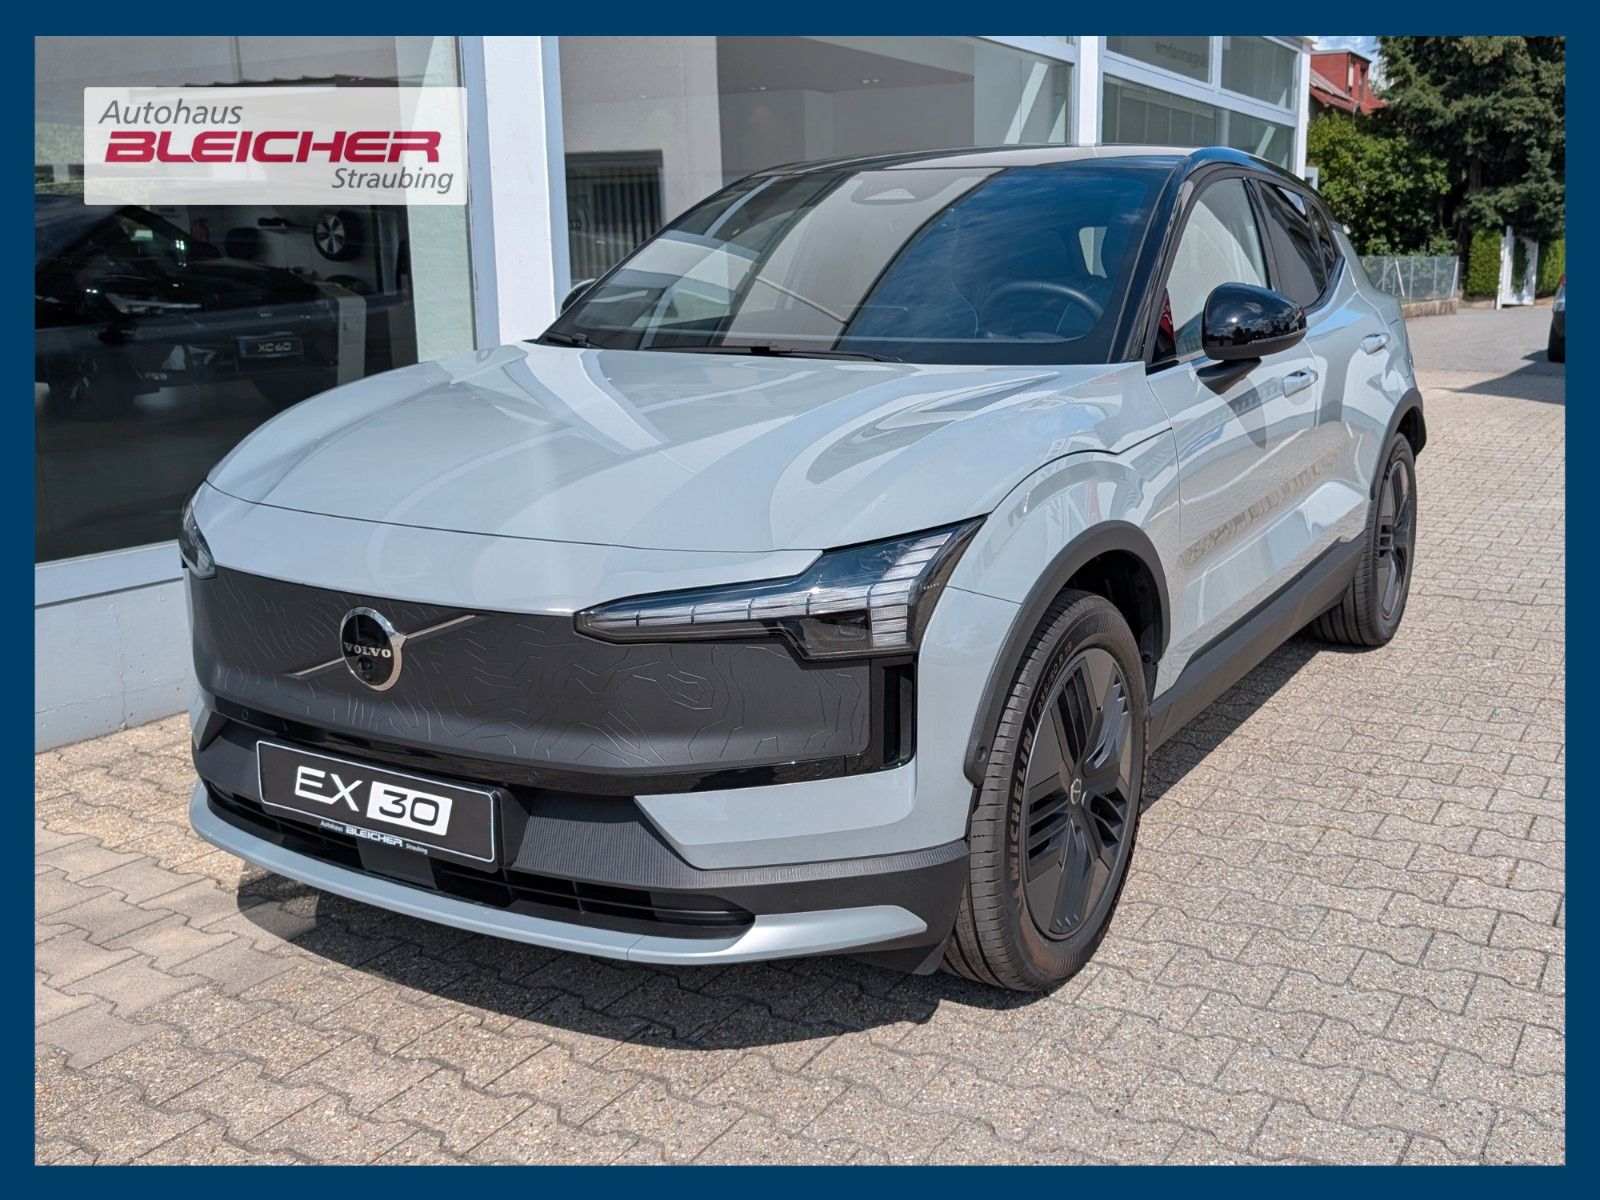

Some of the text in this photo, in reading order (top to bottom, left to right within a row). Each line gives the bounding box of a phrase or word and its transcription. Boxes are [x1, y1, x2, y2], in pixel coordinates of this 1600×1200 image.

[257, 342, 292, 353] XC60
[343, 641, 392, 658] VOLVO
[294, 765, 440, 827] EX 30
[1010, 727, 1033, 881] MICHELIN
[320, 819, 429, 856] Autohaus BLEICHER Straubing
